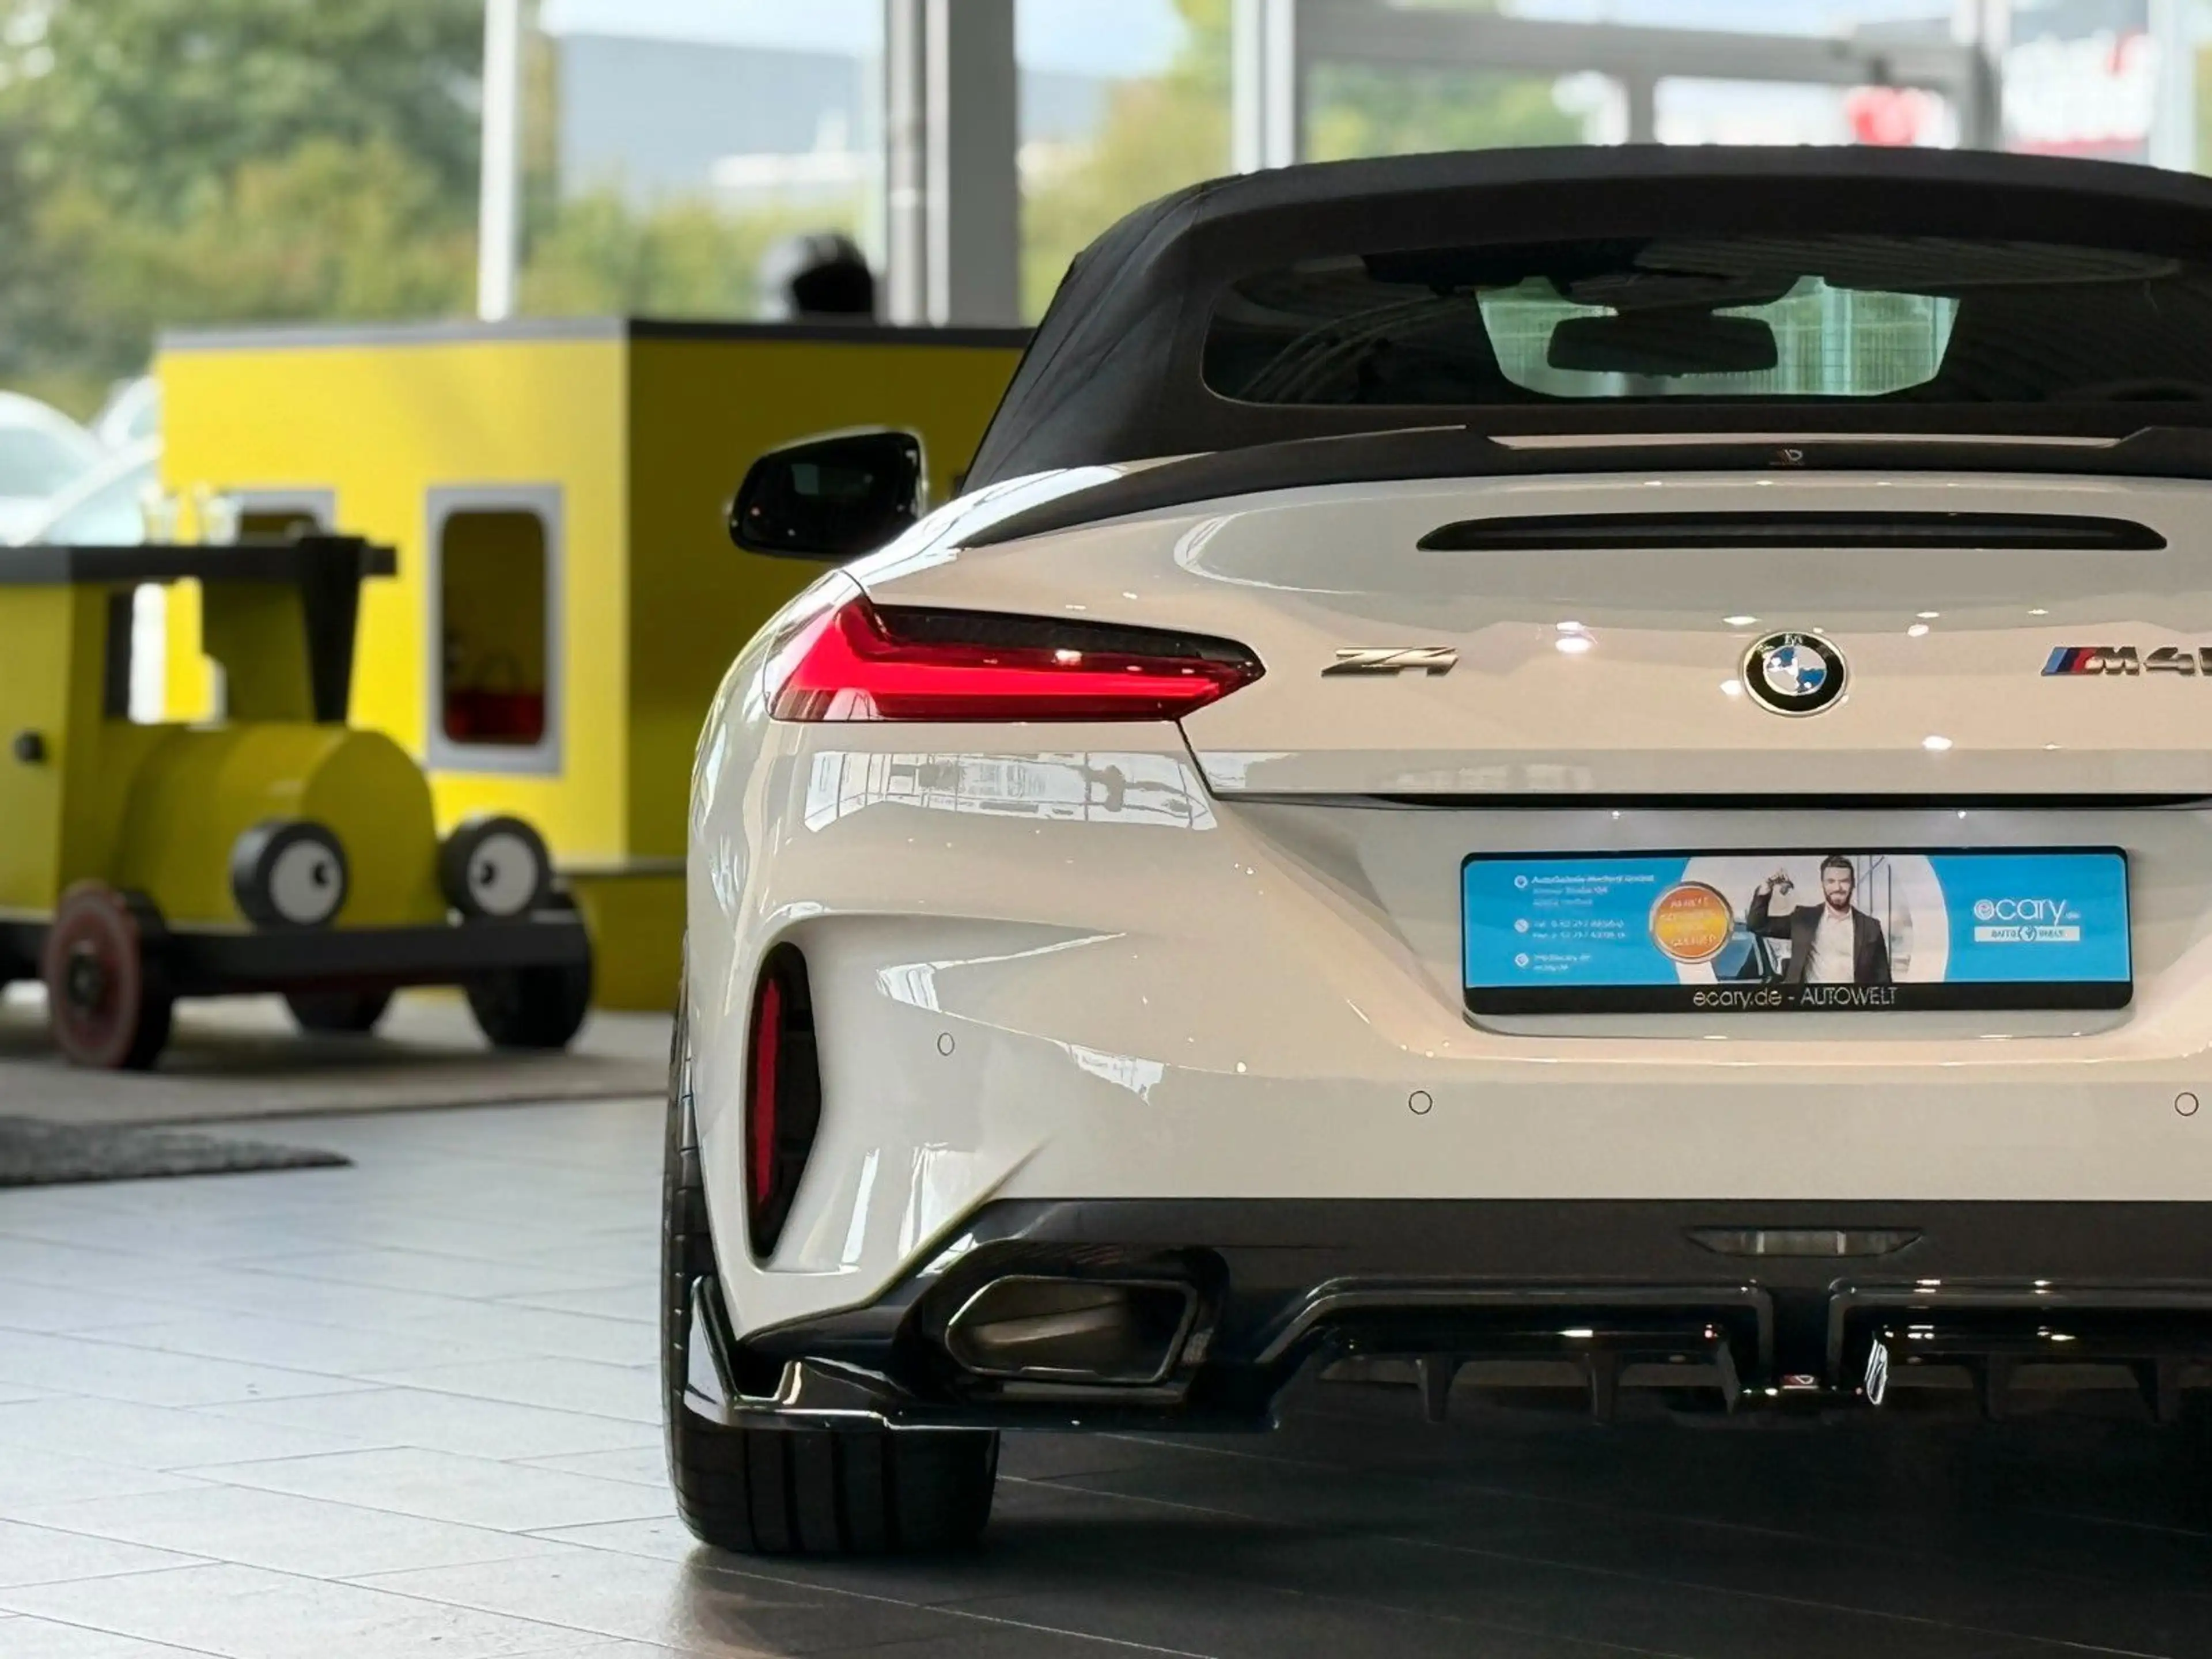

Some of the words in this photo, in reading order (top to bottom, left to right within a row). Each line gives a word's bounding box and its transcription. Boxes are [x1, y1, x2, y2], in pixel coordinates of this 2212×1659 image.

[1321, 646, 1459, 677] Z4
[1692, 989, 1782, 1009] ecary.de
[1800, 987, 1898, 1005] AUTOWELT
